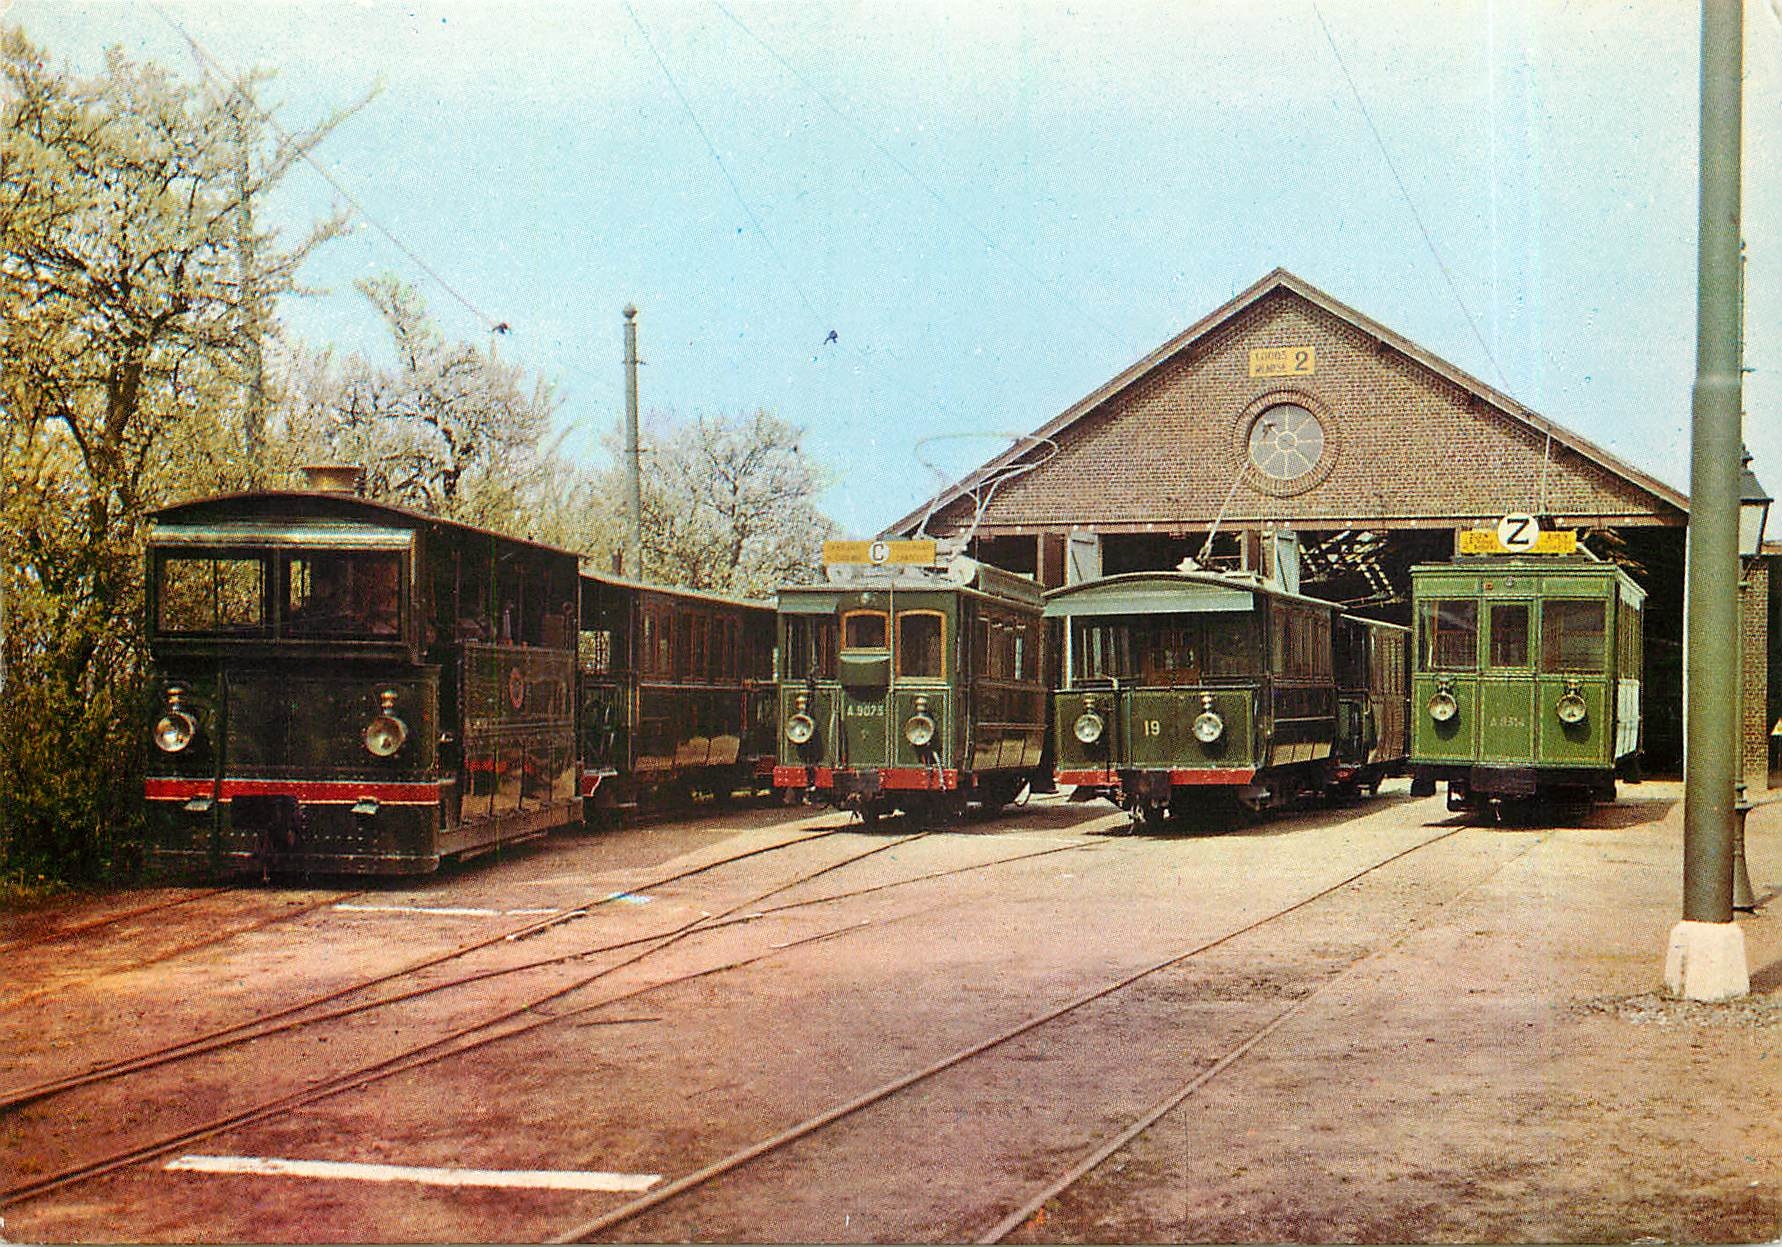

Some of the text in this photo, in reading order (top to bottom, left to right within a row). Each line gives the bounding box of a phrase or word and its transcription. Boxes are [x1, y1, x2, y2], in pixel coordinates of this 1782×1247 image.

[1295, 350, 1309, 371] 2
[1507, 518, 1530, 545] Z
[873, 543, 885, 561] C
[1143, 719, 1160, 737] 19
